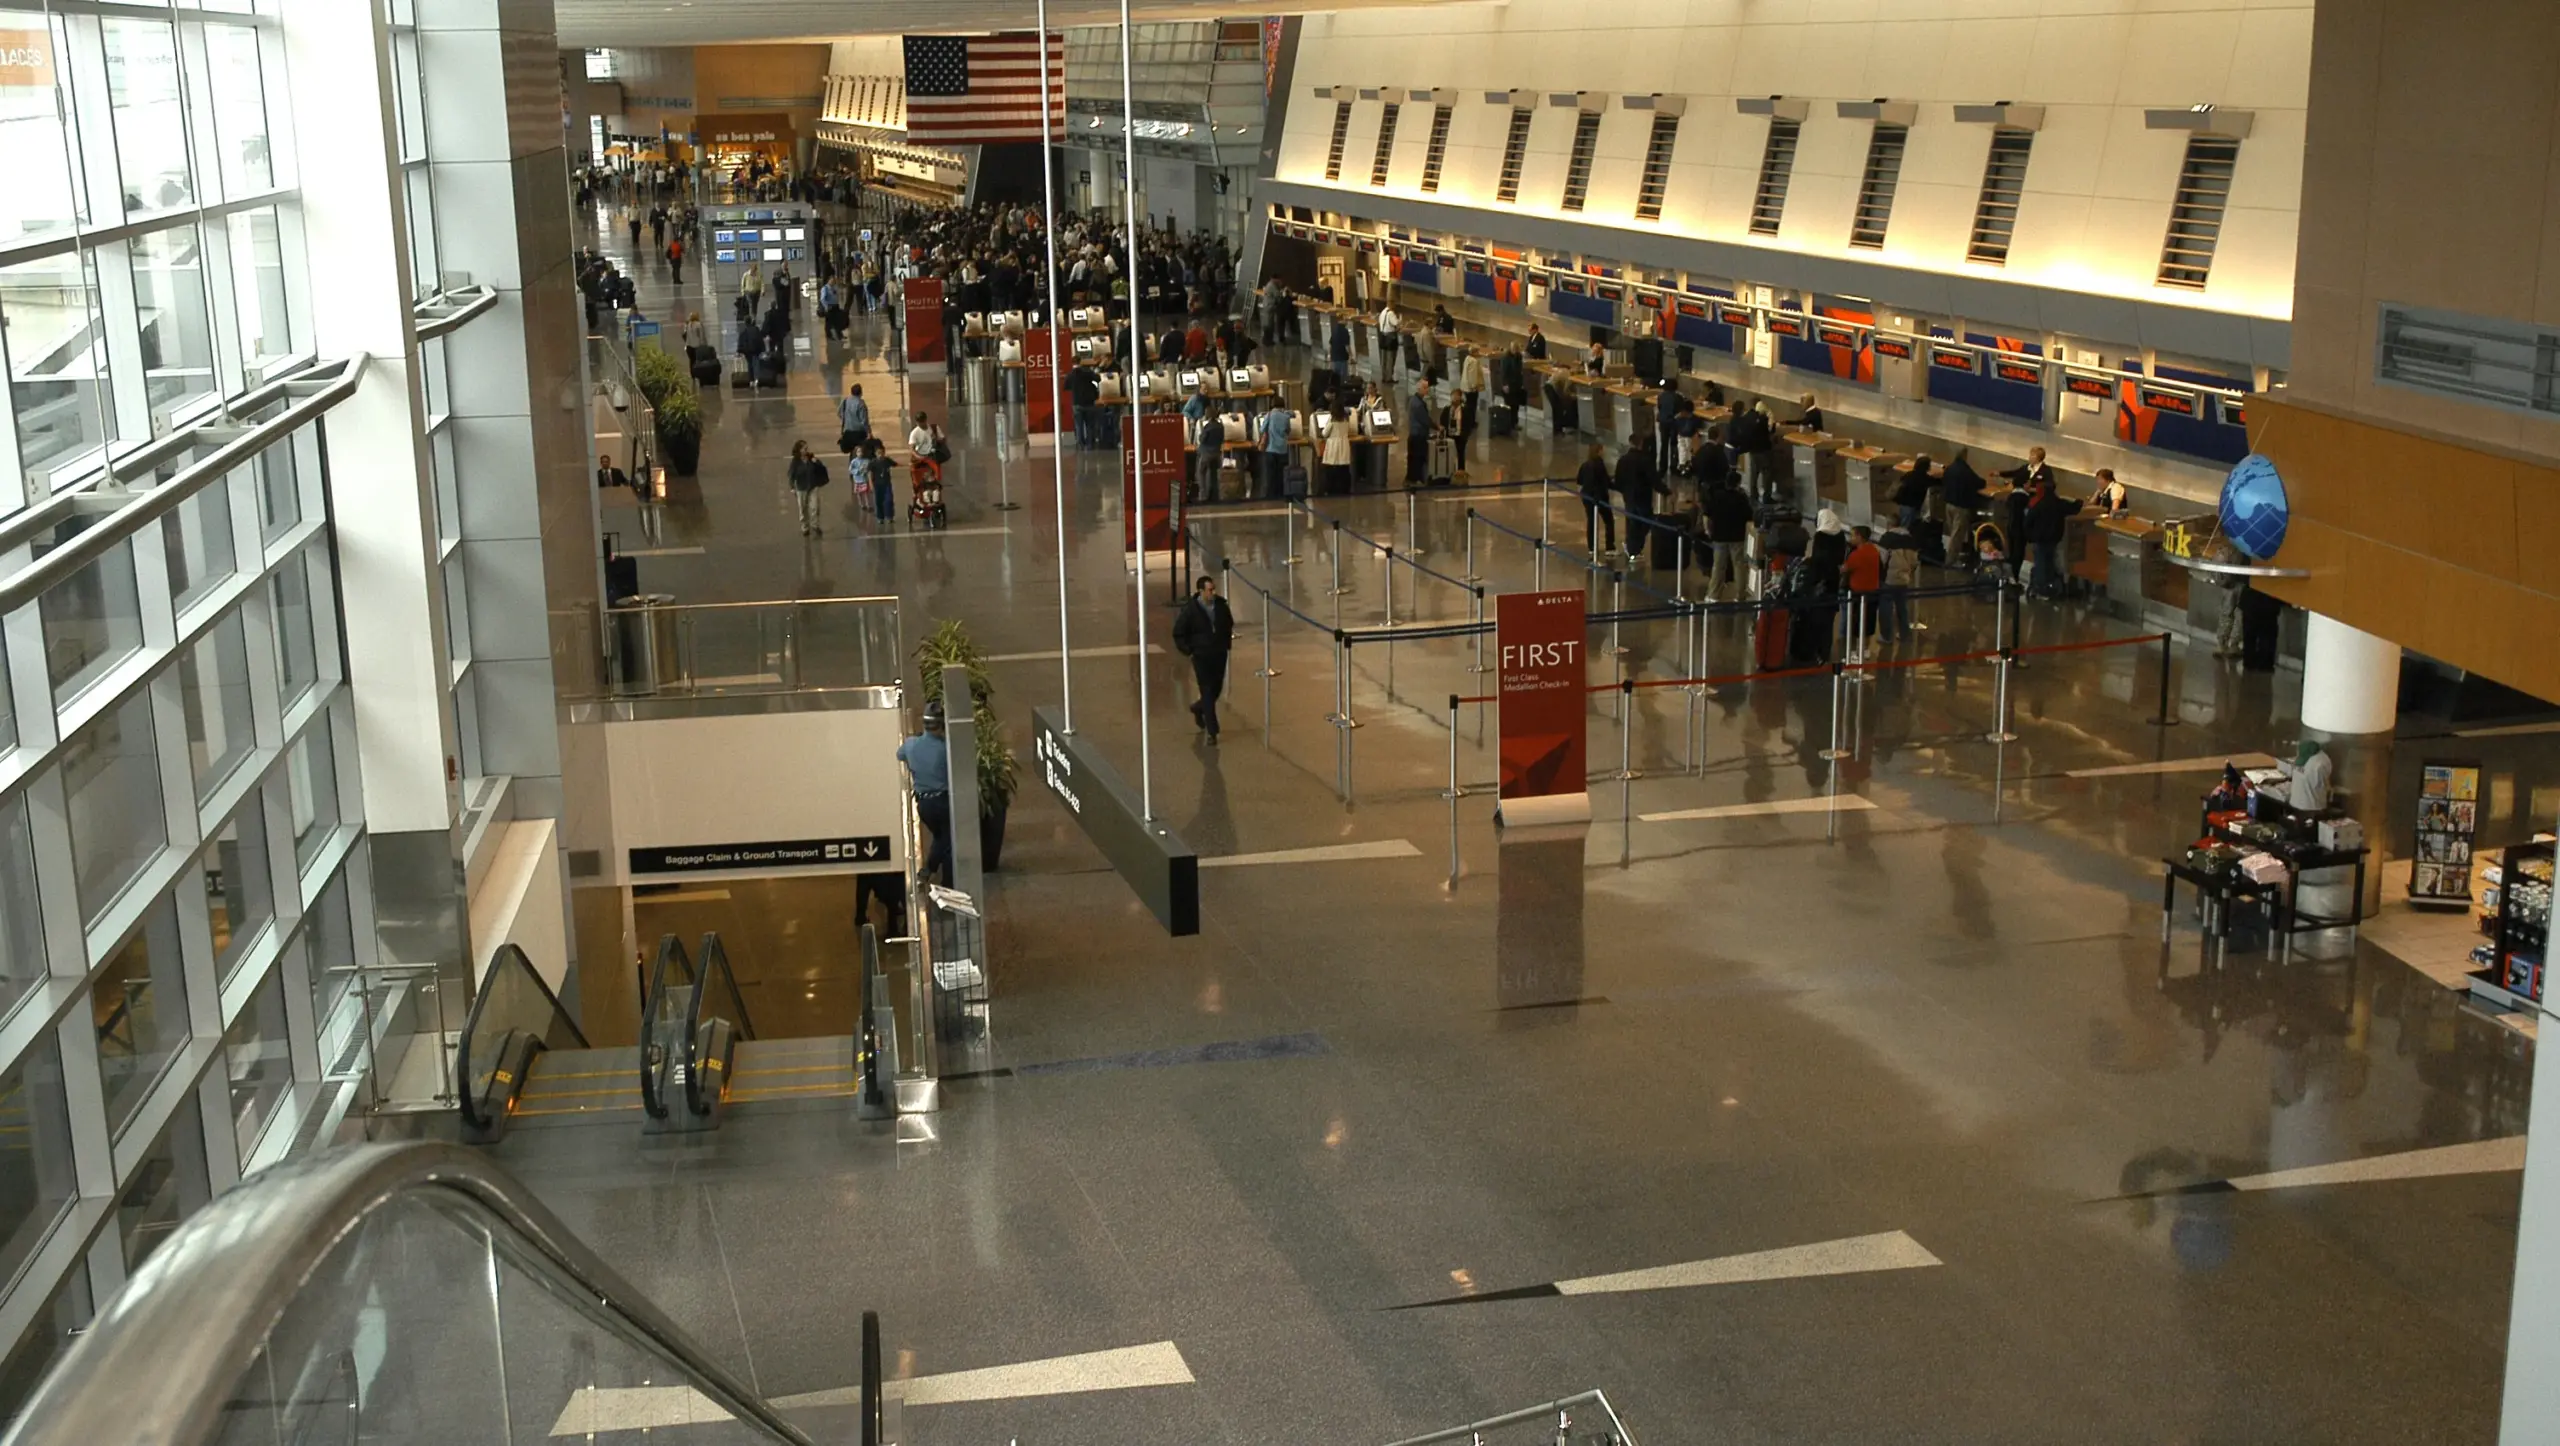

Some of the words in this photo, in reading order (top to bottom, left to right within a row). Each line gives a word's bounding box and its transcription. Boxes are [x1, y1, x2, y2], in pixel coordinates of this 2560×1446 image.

[731, 131, 750, 141] bon
[1027, 354, 1062, 368] SEL
[1545, 596, 1572, 604] DELTA
[1503, 641, 1579, 669] FIRST
[1503, 674, 1519, 683] First
[1520, 673, 1539, 681] Class
[1503, 683, 1538, 692] Medallion
[1539, 680, 1570, 689] Check-in
[665, 855, 705, 865] Baggage
[706, 853, 732, 862] Claim
[743, 851, 775, 860] Ground
[778, 849, 819, 860] Transport
